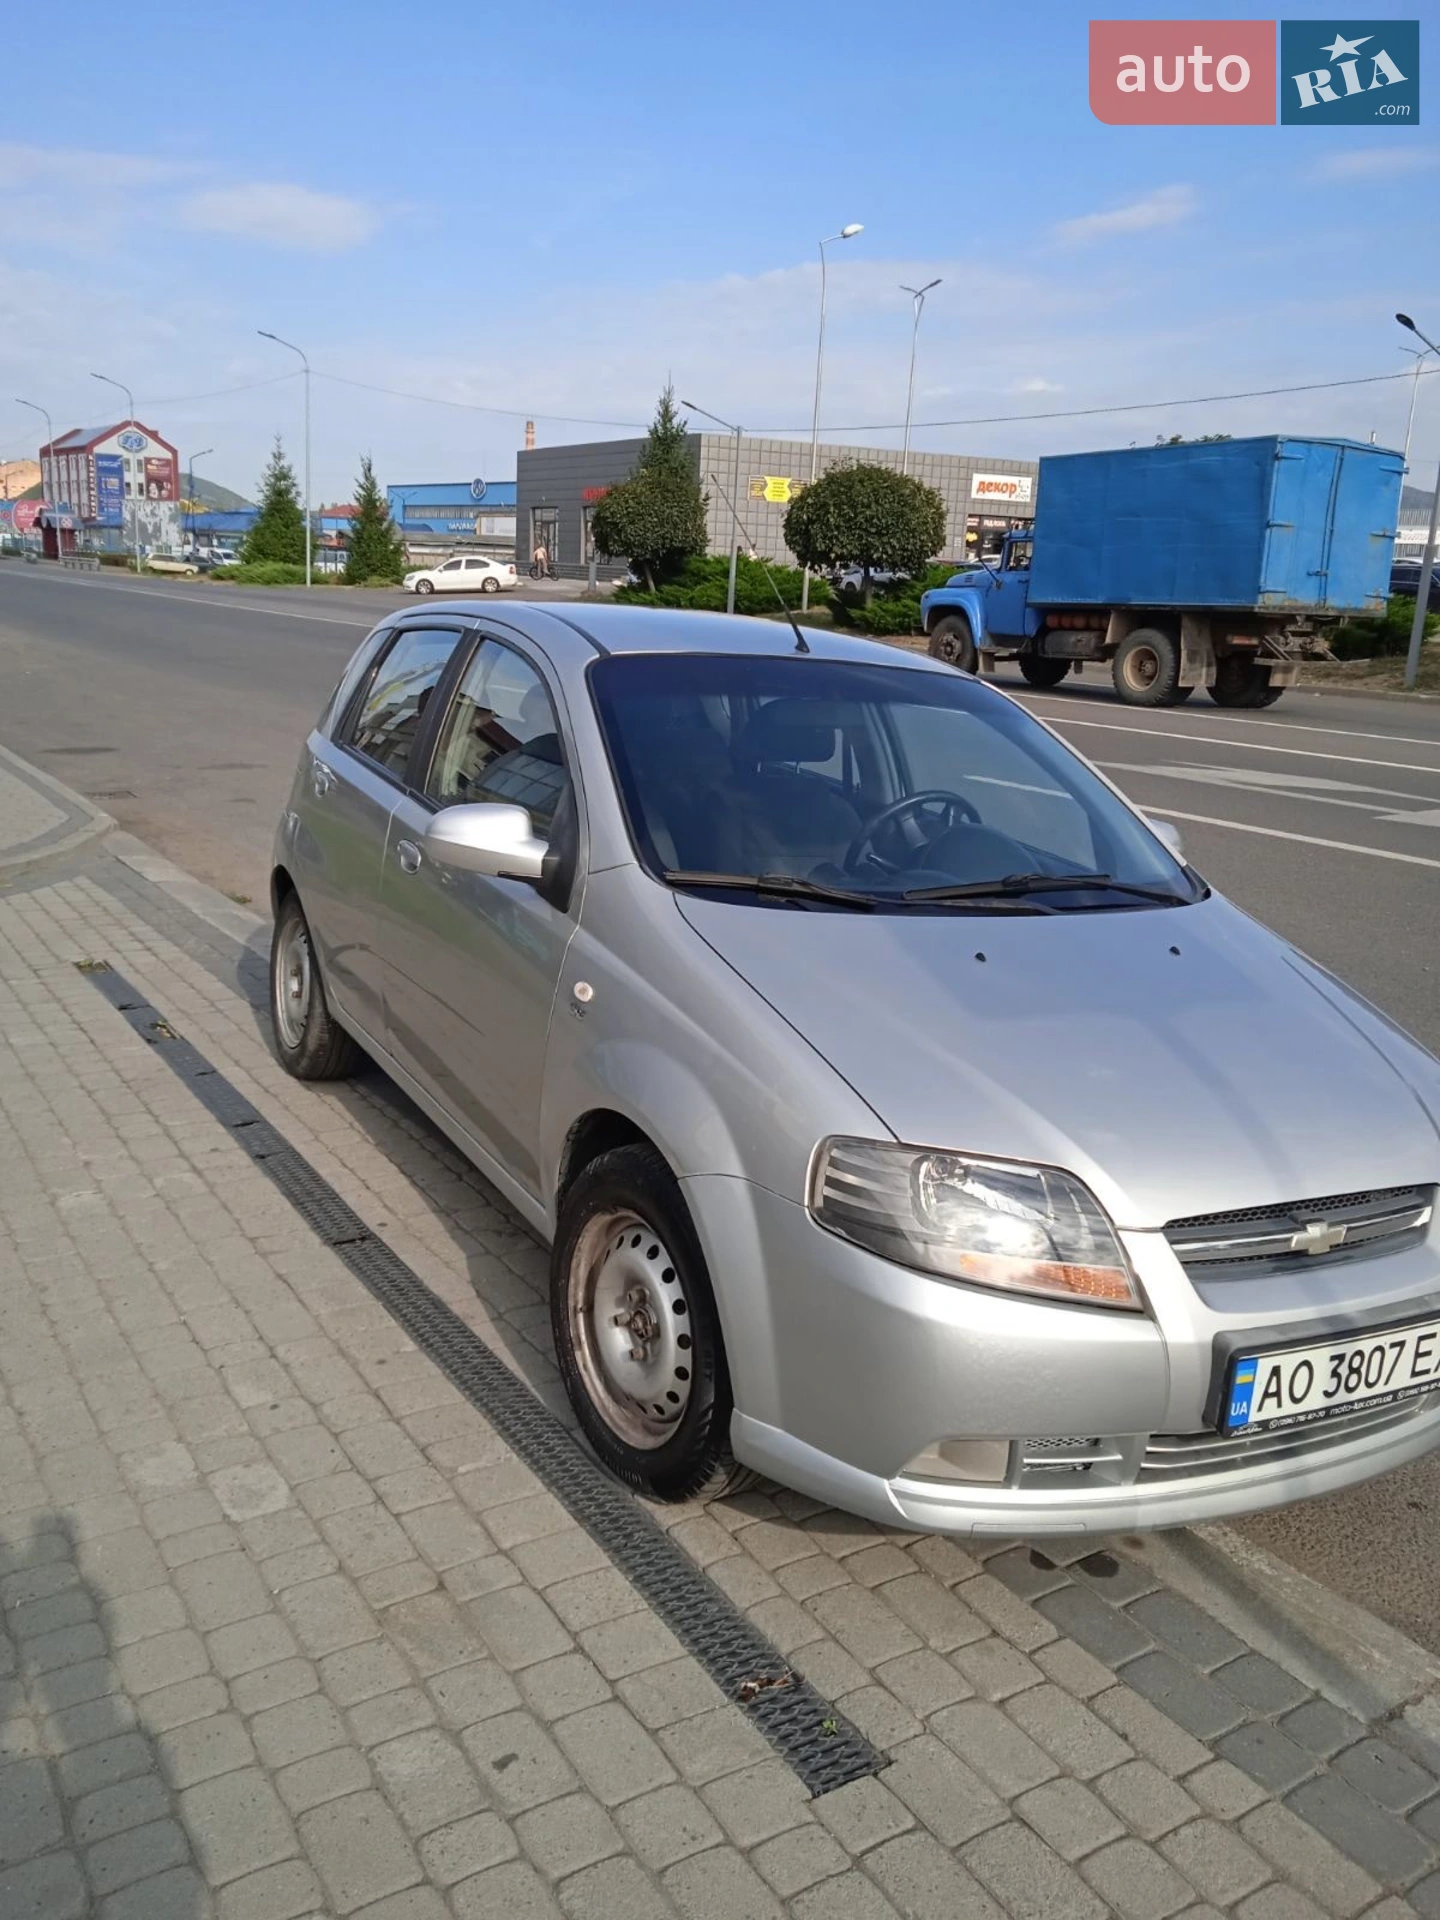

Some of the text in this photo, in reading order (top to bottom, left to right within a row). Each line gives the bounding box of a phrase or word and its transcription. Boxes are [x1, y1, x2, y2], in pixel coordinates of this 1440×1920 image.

[976, 480, 1017, 498] декор
[1257, 1332, 1440, 1412] AO 3807 E
[1230, 1401, 1248, 1417] UA
